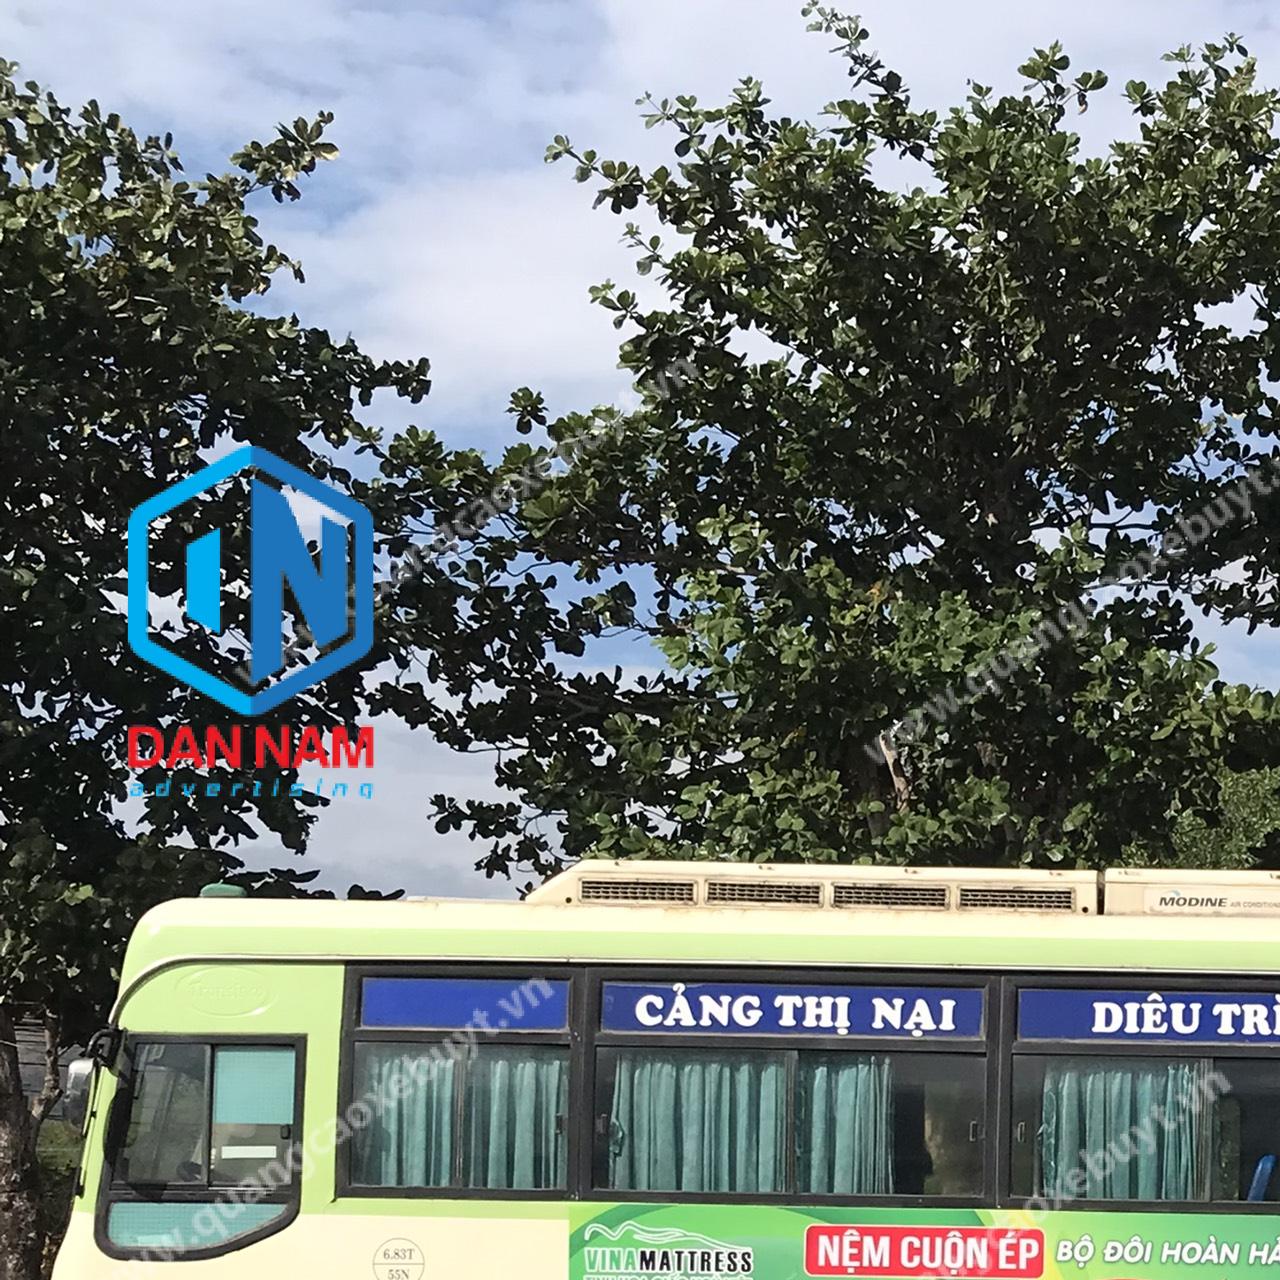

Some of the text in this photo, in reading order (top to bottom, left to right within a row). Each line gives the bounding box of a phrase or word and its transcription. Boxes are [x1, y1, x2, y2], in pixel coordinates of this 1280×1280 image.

[1159, 897, 1228, 908] MODINE
[635, 982, 956, 1037] CẢNG THỊ NẠI
[383, 1247, 416, 1260] 6.83T
[585, 1248, 753, 1273] VINAMATTRESS
[817, 1229, 1040, 1275] NỆM CUỘN ÉP
[1056, 1233, 1096, 1269] BỘ
[1103, 1234, 1153, 1264] ĐÔI
[1160, 1235, 1240, 1266] HOÀN
[387, 1269, 410, 1280] 55N
